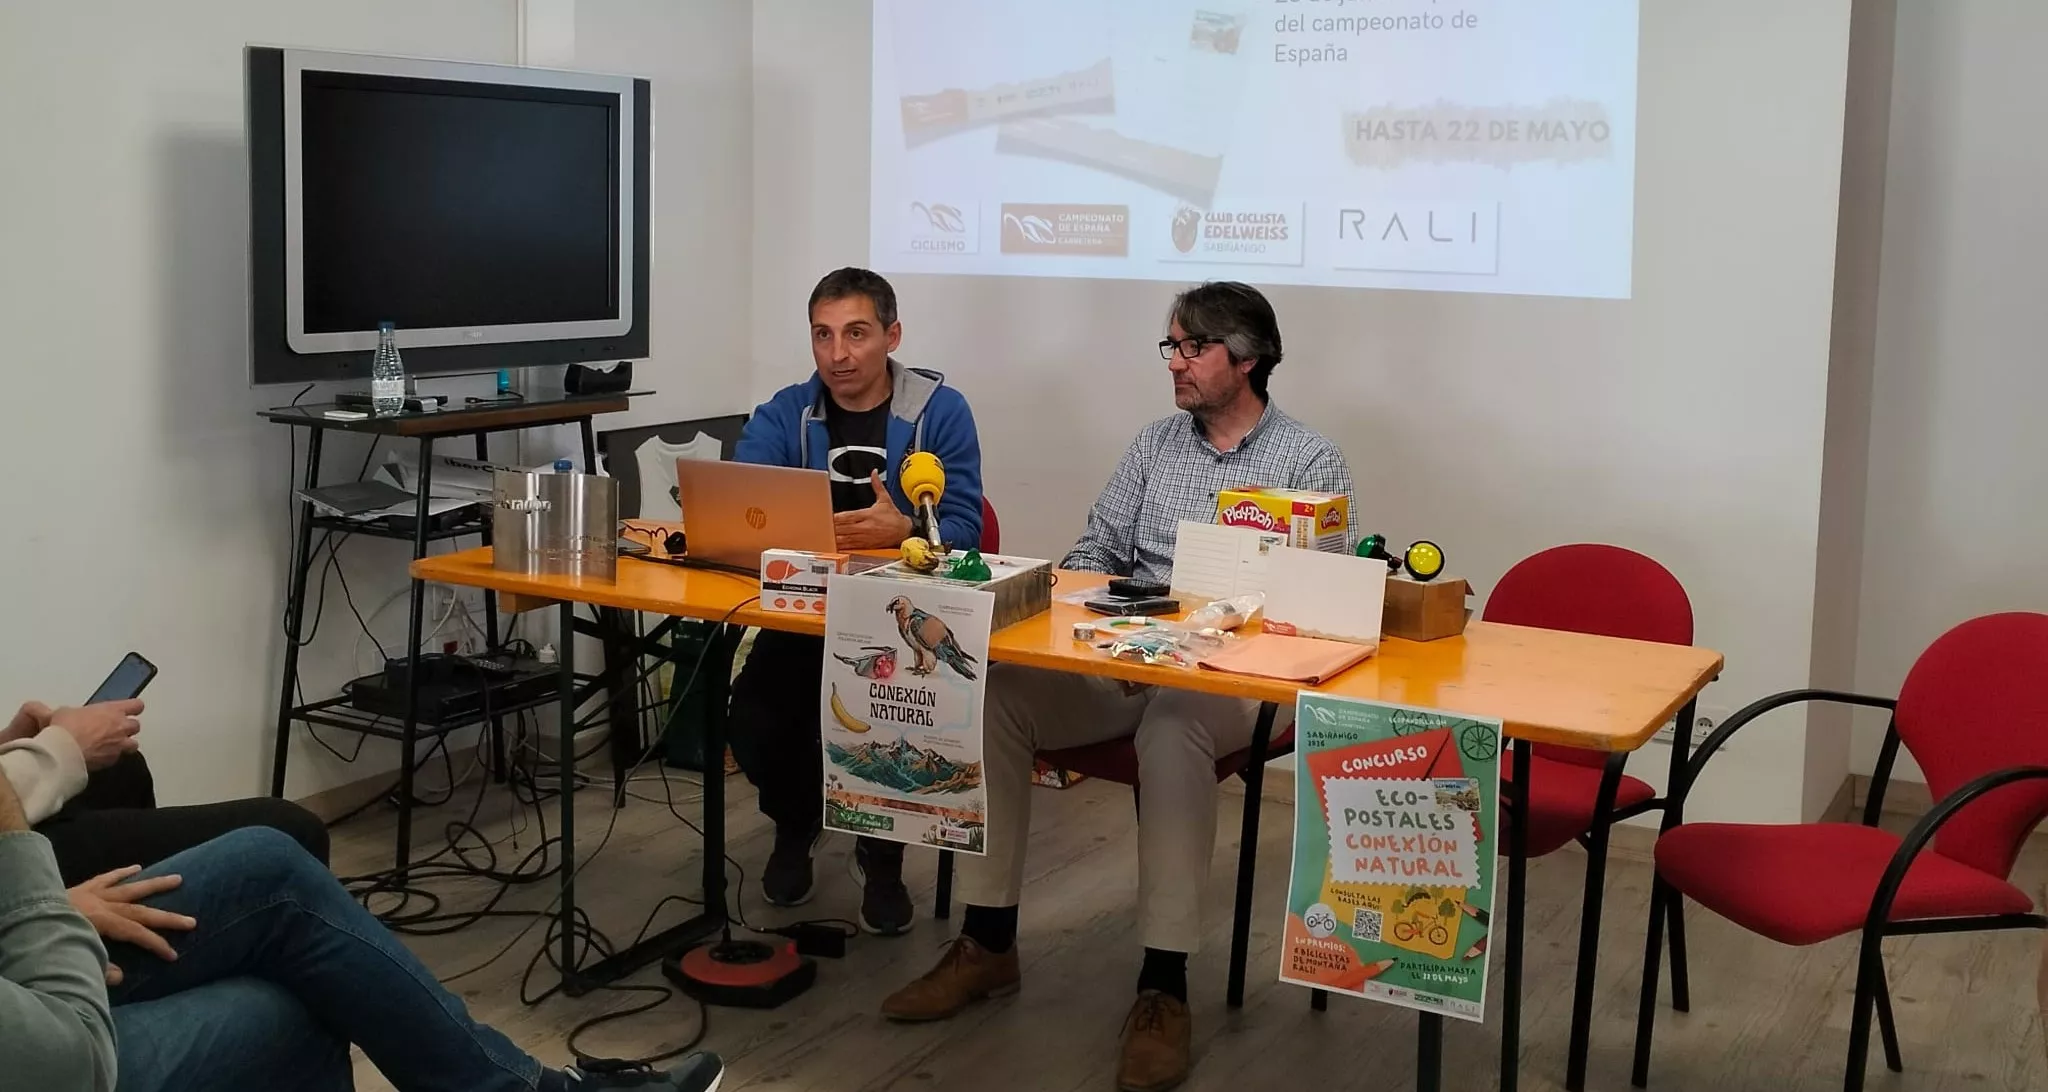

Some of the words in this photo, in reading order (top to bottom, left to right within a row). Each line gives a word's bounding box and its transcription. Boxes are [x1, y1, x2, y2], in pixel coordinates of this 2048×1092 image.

[1275, 14, 1304, 32] del
[1312, 12, 1443, 36] campeonato
[1451, 10, 1478, 29] de
[1275, 43, 1348, 67] España
[1356, 120, 1438, 142] HASTA
[1447, 120, 1480, 142] 22
[1489, 120, 1519, 142] DE
[1527, 119, 1611, 143] MAYO
[1058, 213, 1125, 223] CAMPEONATO
[1204, 212, 1233, 224] CLUB
[1236, 212, 1287, 225] CICLISTA
[1339, 208, 1477, 243] RALI
[1058, 224, 1072, 233] DE
[1073, 222, 1111, 234] ESPAÑA
[1204, 224, 1289, 241] EDELWEISS
[911, 240, 966, 252] CICLISMO
[1304, 504, 1314, 513] 2+
[869, 683, 937, 708] CONEXIÓN
[870, 702, 934, 727] NATURAL
[1342, 746, 1427, 772] CONCURSO
[1376, 789, 1429, 807] ECO-
[1344, 808, 1455, 830] POSTALES
[1346, 833, 1457, 854] CONEXIÓN
[1355, 856, 1462, 878] NATURAL
[1330, 888, 1366, 900] CONSULTA
[1368, 895, 1381, 904] LAS
[1293, 956, 1304, 964] DE
[1301, 948, 1350, 964] BICICLETAS
[1400, 962, 1445, 972] PARTICIPA
[1447, 966, 1476, 975] HASTA
[1432, 974, 1443, 982] DE
[1445, 974, 1468, 985] MAYO
